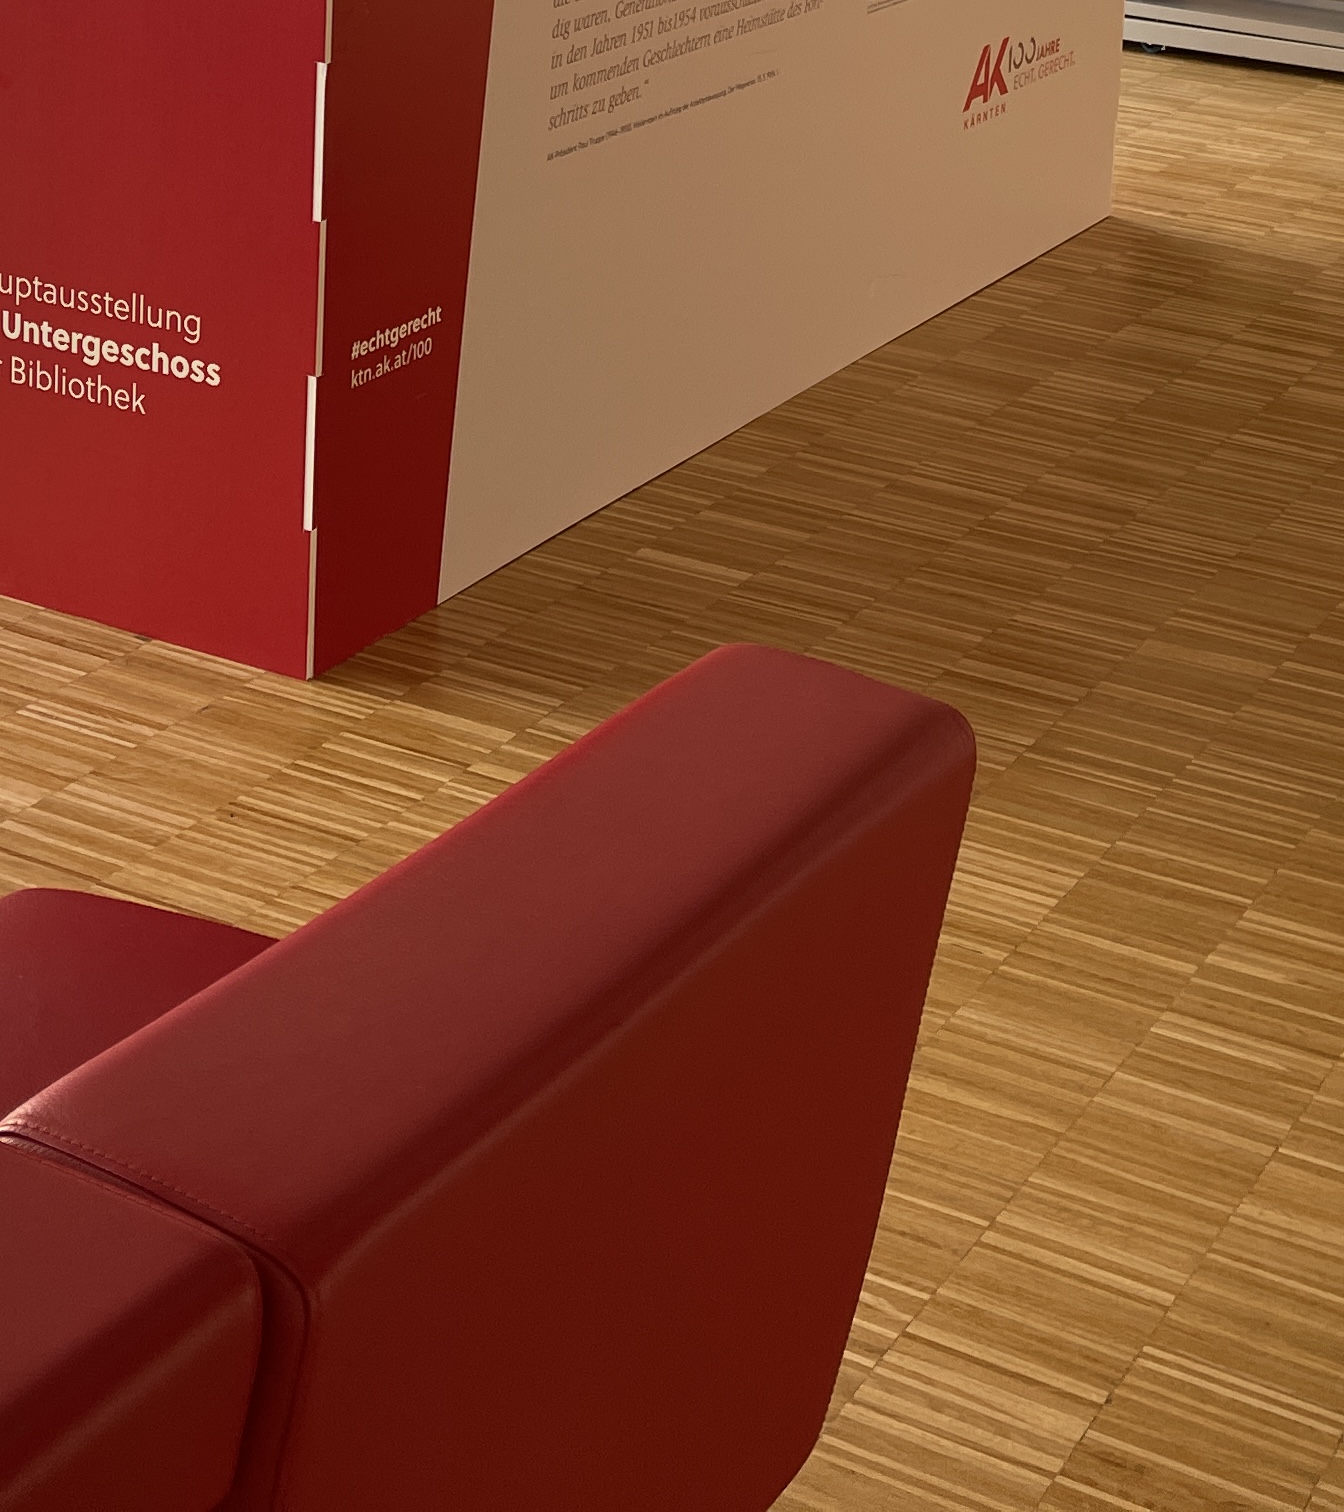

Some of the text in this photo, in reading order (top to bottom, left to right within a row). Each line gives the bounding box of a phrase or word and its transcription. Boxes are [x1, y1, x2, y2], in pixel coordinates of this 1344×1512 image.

[551, 51, 563, 69] in
[567, 42, 587, 65] den
[590, 30, 627, 58] Jahren
[552, 19, 570, 40] dig
[550, 81, 568, 100] um
[572, 56, 639, 92] kommenden
[713, 25, 734, 44] eine
[963, 37, 1010, 113] AK
[1036, 38, 1061, 62] JAHRE
[592, 97, 605, 115] zu
[963, 103, 1007, 130] KÄRNTEN
[2, 308, 221, 386] Untergeschoss
[351, 304, 442, 360] #echtgerecht
[10, 358, 146, 415] Bibliothek
[350, 338, 433, 389] ktn.ak.at/100
